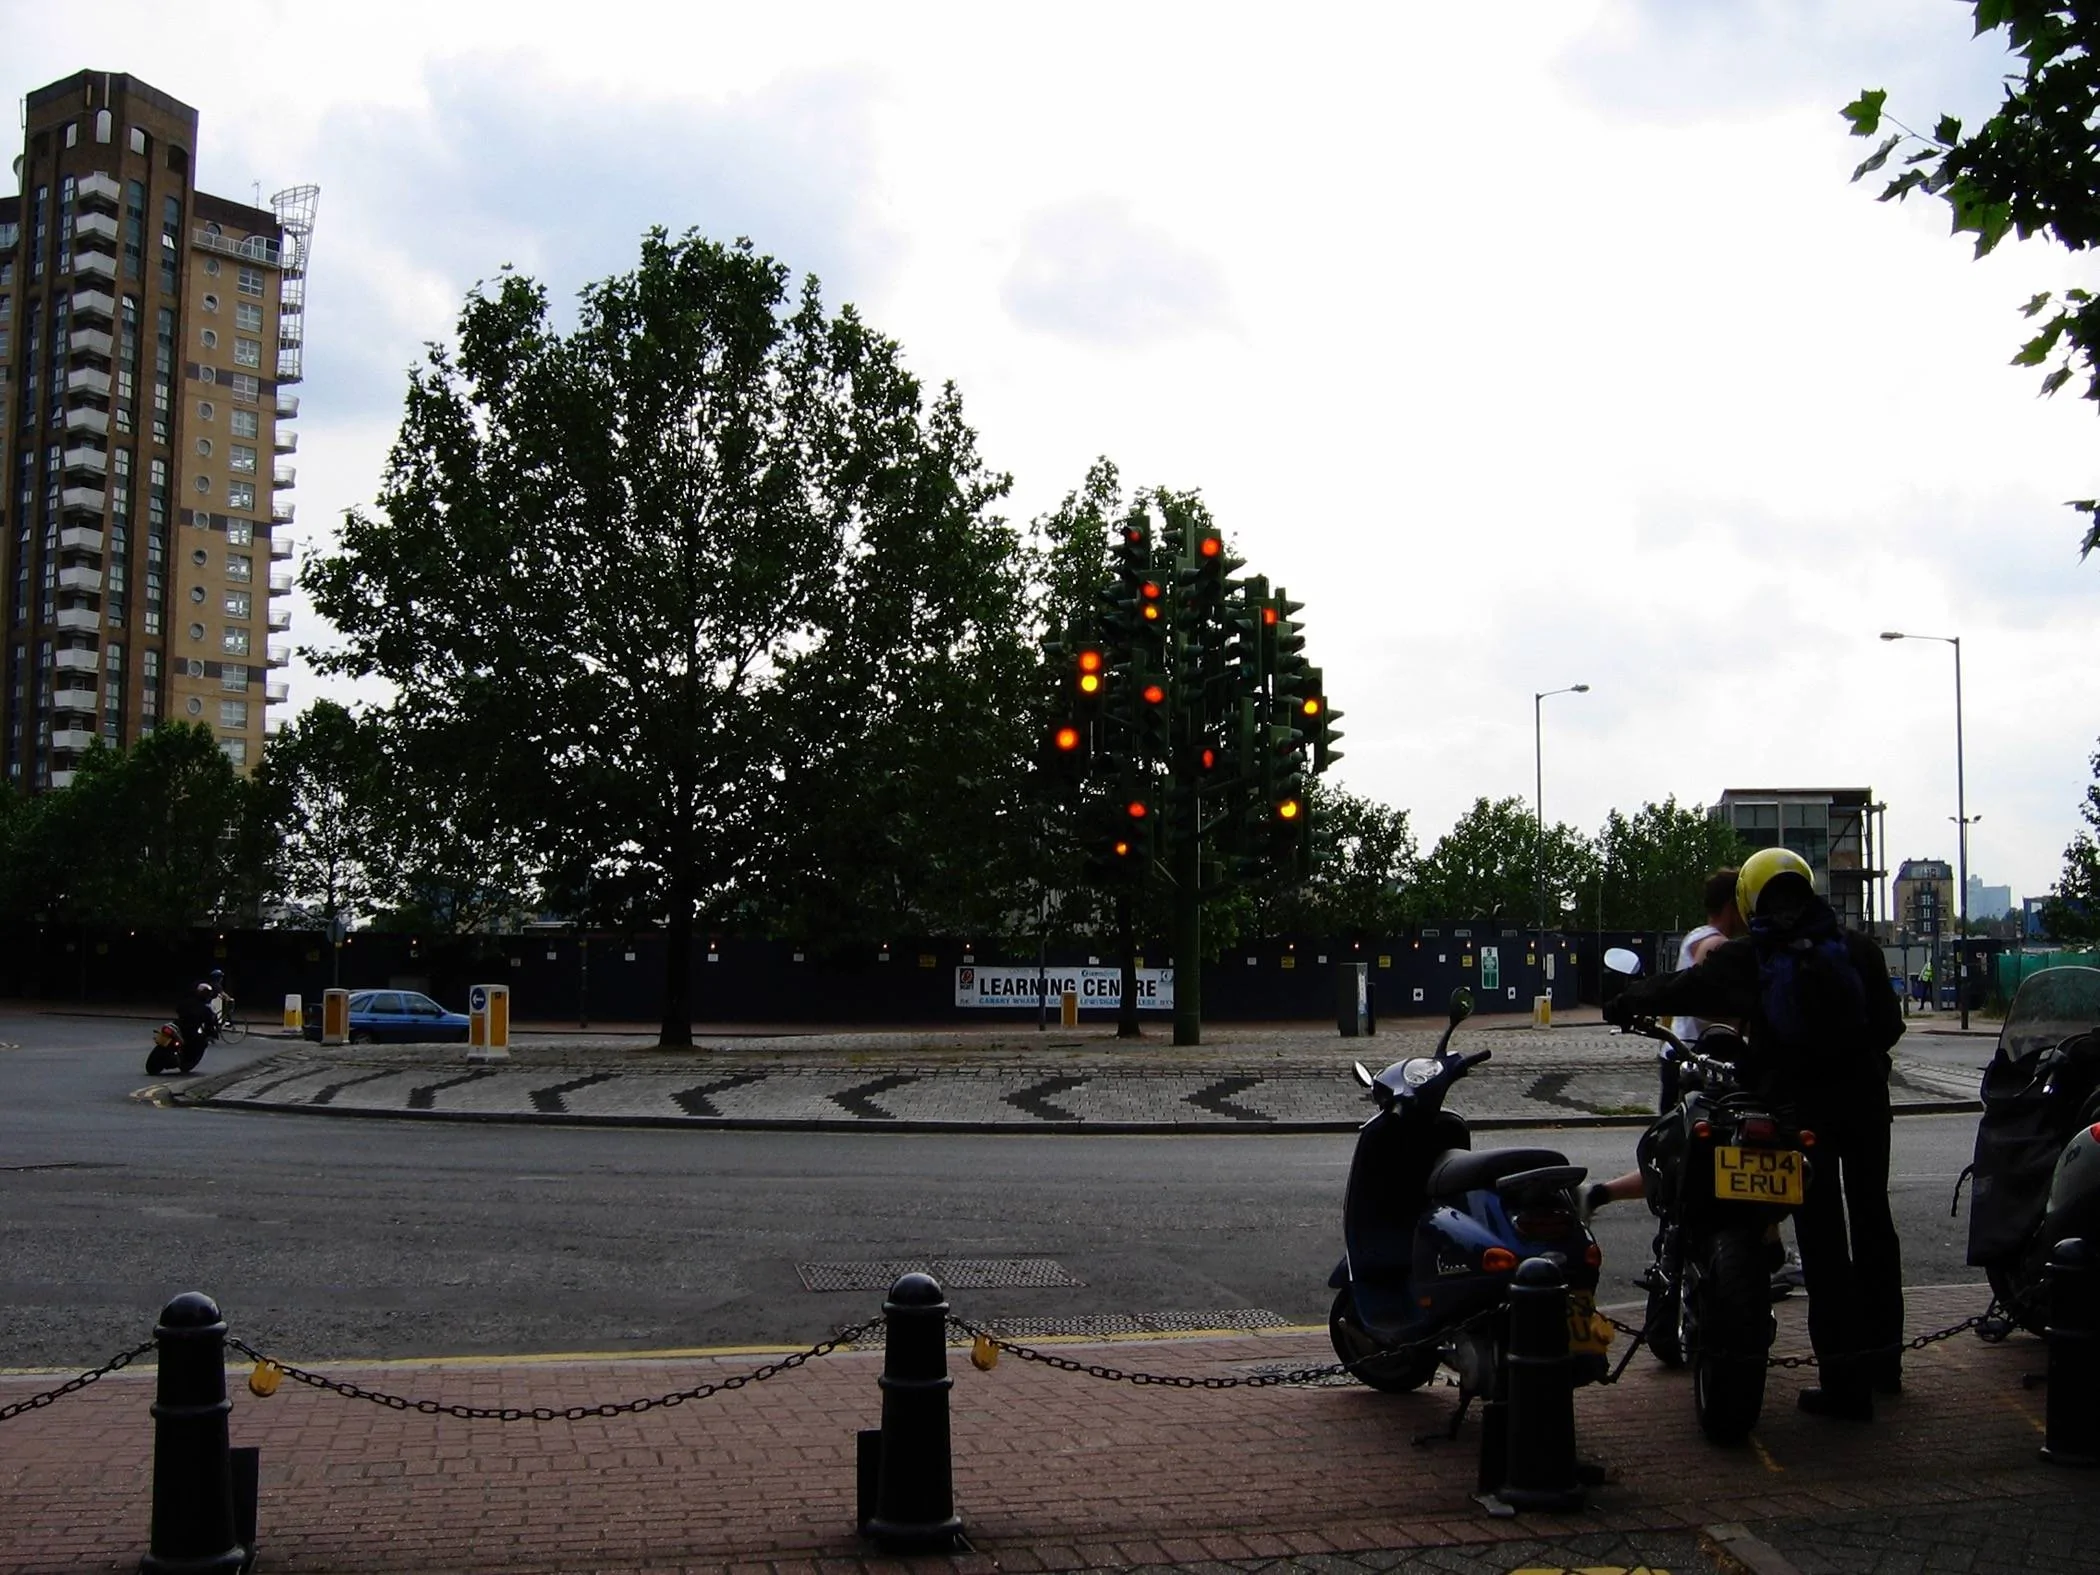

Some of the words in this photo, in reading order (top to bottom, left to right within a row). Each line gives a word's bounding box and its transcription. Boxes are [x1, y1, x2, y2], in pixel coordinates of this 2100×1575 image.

[980, 978, 1076, 996] LEARNING
[1083, 979, 1157, 997] CENRE
[1720, 1149, 1796, 1174] LF04
[1730, 1172, 1787, 1195] ERU
